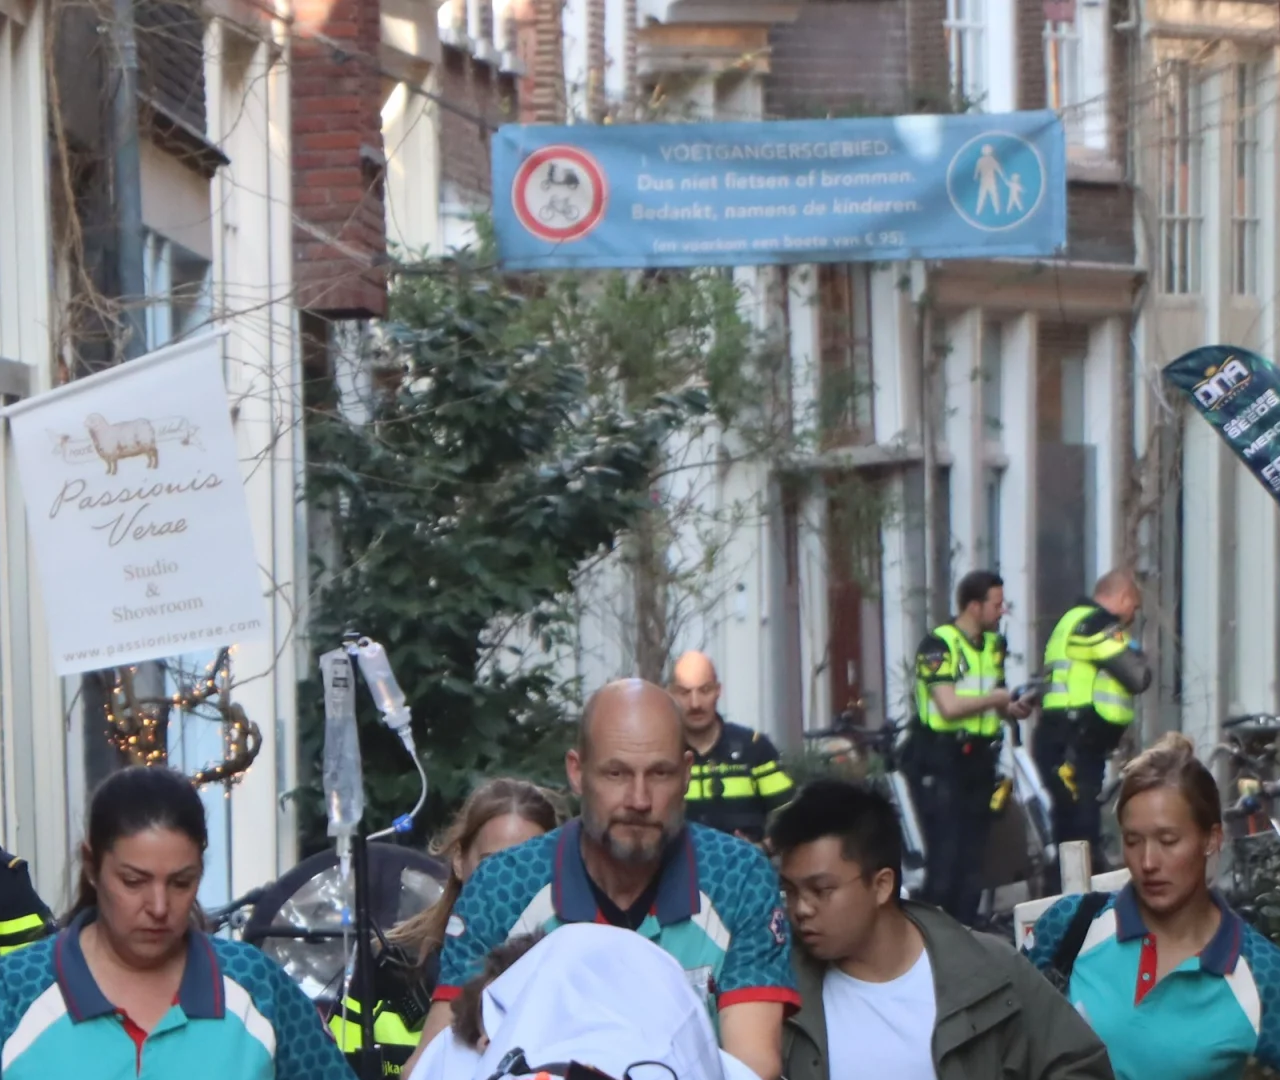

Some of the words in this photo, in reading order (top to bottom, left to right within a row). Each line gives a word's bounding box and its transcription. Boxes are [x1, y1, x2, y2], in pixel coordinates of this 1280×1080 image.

[637, 174, 674, 191] Dus
[681, 173, 718, 190] niet
[725, 171, 789, 188] fietsen
[795, 170, 816, 187] of
[821, 169, 917, 187] brommen.
[632, 203, 718, 221] Bedankt,
[725, 204, 797, 219] namens
[803, 200, 827, 216] de
[1194, 360, 1248, 408] DNA
[1228, 396, 1280, 439] SEEDS
[91, 503, 188, 547] Verae
[123, 558, 179, 582] Studio
[144, 582, 160, 599] &
[111, 595, 204, 623] Showroom
[63, 618, 261, 662] www.passionisverae.com
